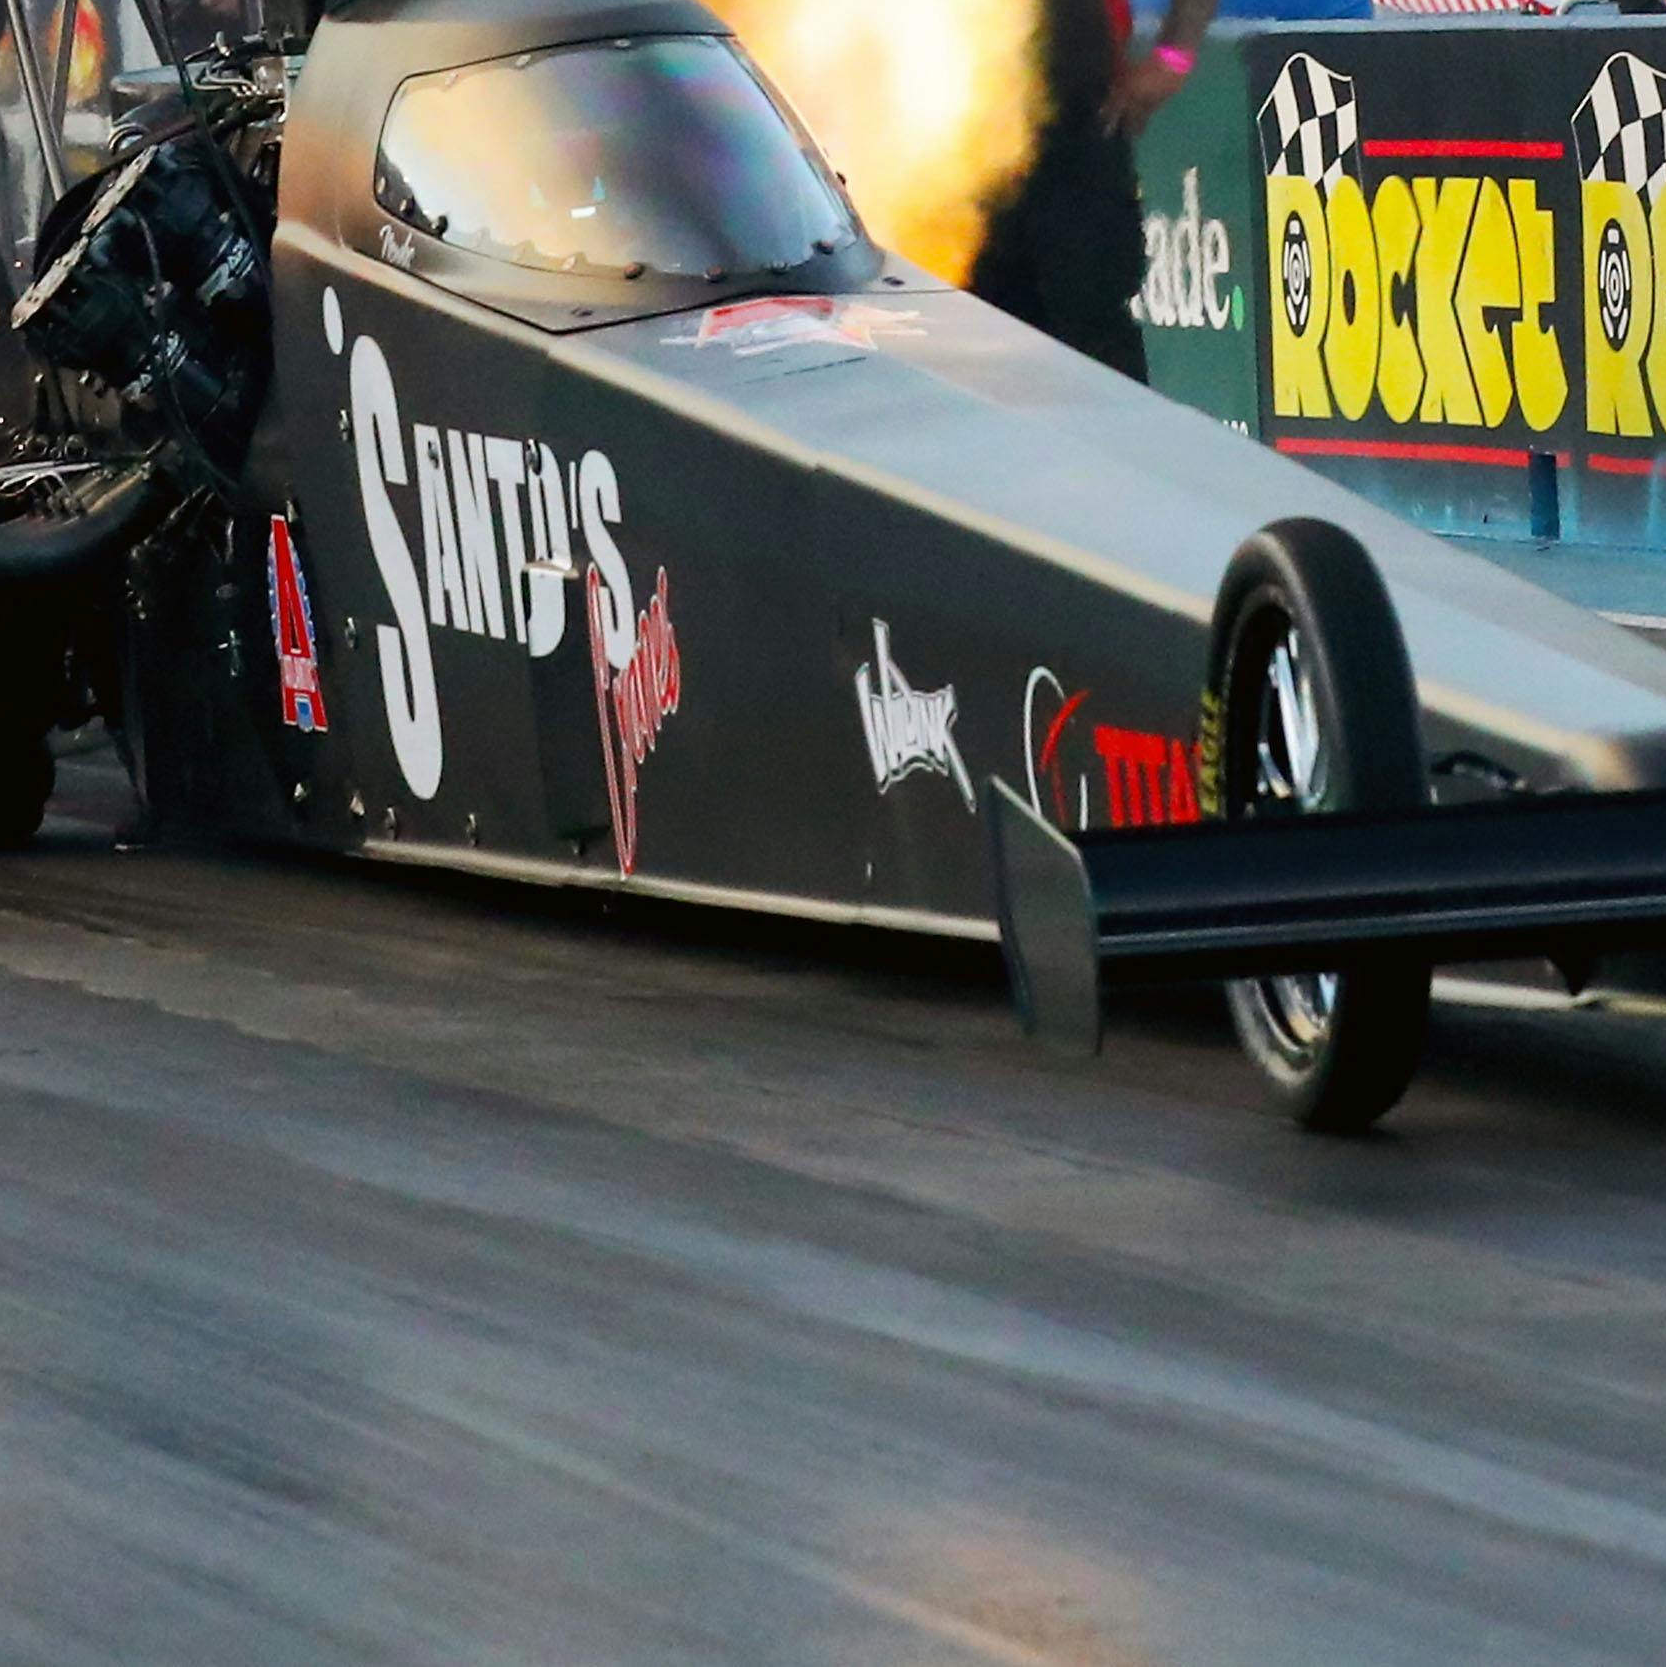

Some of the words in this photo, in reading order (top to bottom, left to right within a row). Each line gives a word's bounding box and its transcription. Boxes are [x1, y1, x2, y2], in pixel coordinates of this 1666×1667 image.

[1128, 165, 1245, 331] ade.
[349, 335, 635, 801] SANTO'S
[1093, 723, 1203, 829] TITA
